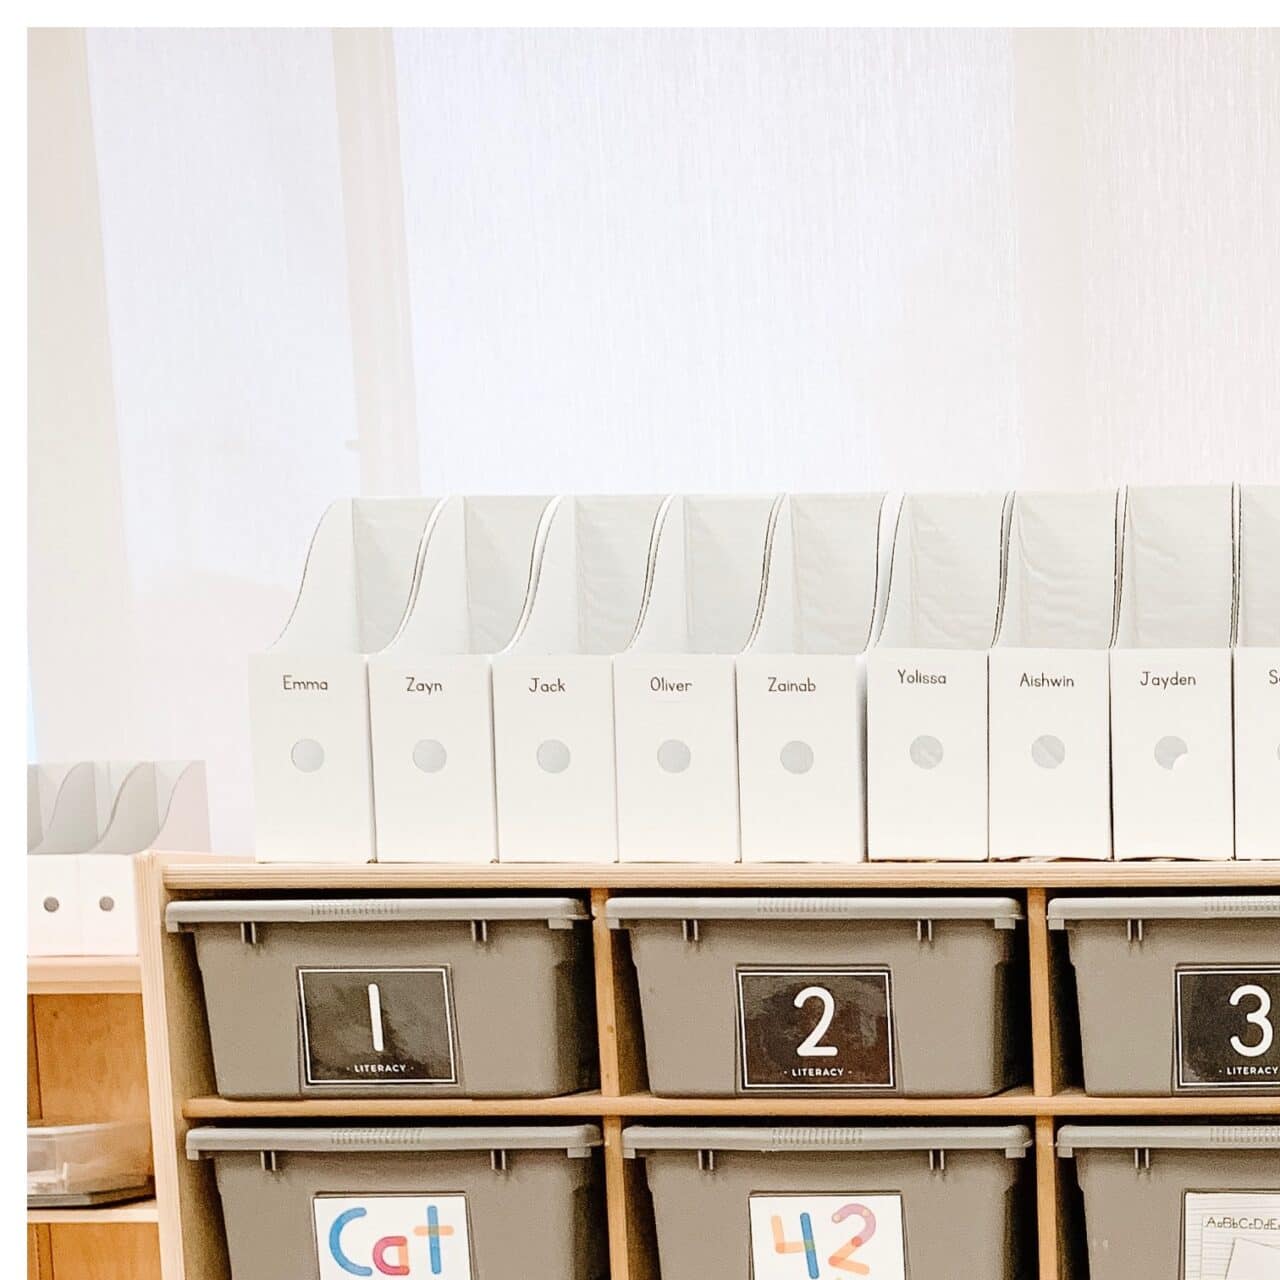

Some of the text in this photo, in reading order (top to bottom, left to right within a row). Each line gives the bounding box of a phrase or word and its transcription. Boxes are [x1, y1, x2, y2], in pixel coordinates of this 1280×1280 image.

[282, 674, 328, 691] Emma
[528, 677, 566, 693] Jack
[650, 676, 693, 692] Oliver
[767, 676, 817, 692] Zainab
[897, 669, 947, 685] Yolissa
[1019, 672, 1075, 688] Aishwin
[1140, 671, 1196, 690] Jayden
[406, 676, 443, 695] Zayn
[367, 983, 384, 1052] 1
[793, 986, 838, 1057] 2
[1229, 984, 1273, 1057] 3
[353, 1063, 406, 1074] LITERACY
[791, 1066, 844, 1078] LITERACY
[1226, 1065, 1279, 1077] LITERACY
[329, 1205, 454, 1277] Cat
[771, 1203, 876, 1279] 42
